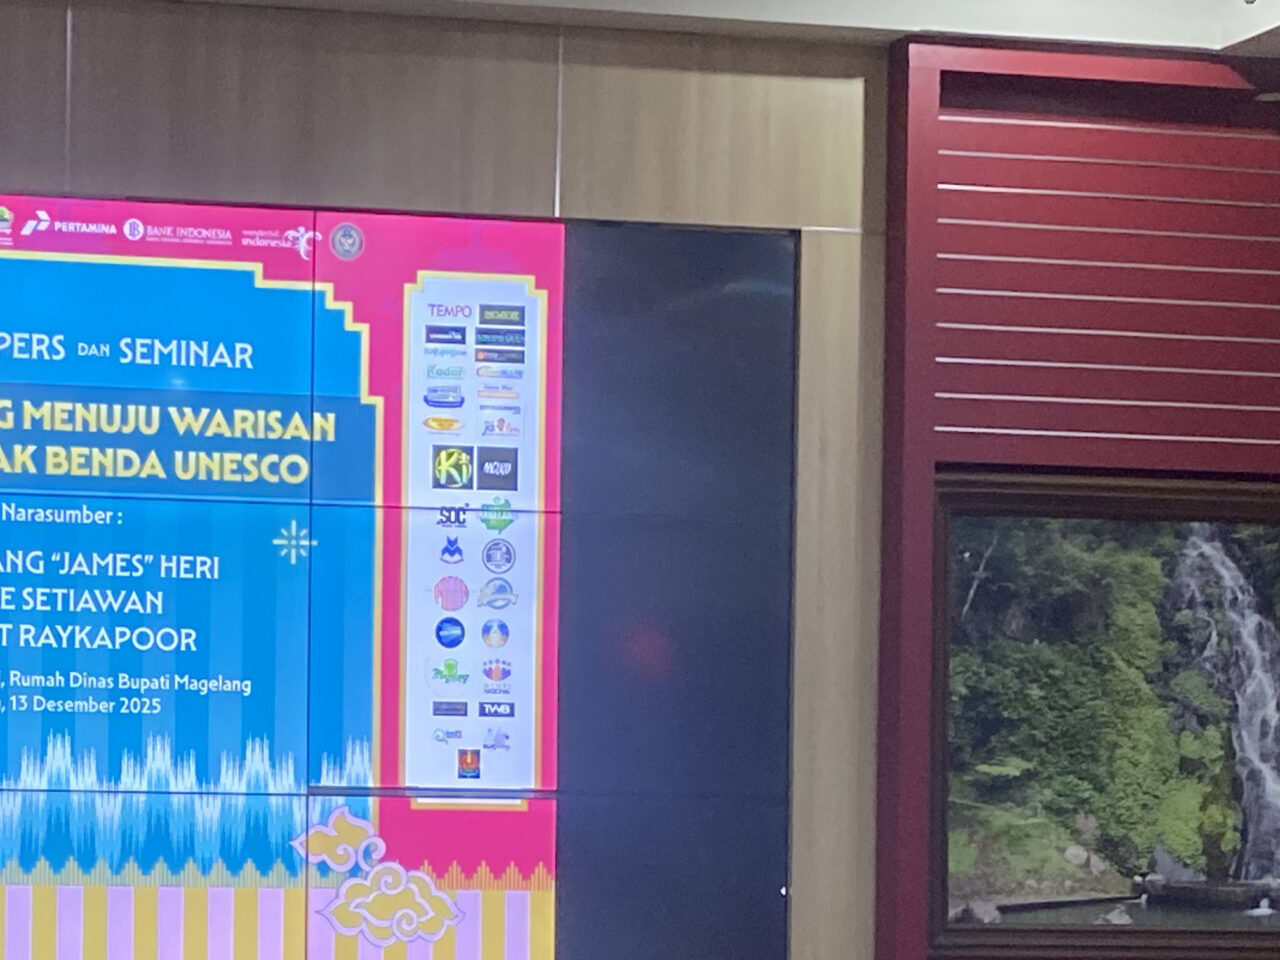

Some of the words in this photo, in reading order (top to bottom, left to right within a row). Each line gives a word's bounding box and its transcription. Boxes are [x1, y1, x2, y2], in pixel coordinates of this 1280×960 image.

[55, 220, 117, 235] PERTAMINA
[146, 225, 174, 237] BANK
[176, 226, 232, 240] INDONESIA
[427, 303, 472, 318] TEMPO
[77, 342, 110, 358] DAN
[119, 337, 254, 370] SEMINAR
[22, 400, 161, 436] MENUJU
[168, 406, 336, 442] WARISAN
[45, 445, 167, 479] BENDA
[174, 450, 310, 484] UNESCO
[1, 502, 113, 525] Narasumber
[160, 555, 220, 580] HERI
[21, 587, 164, 615] SETIAWAN
[18, 624, 197, 652] RAYKAPOOR
[9, 671, 66, 690] Rumah
[69, 673, 115, 690] Dinas
[118, 674, 170, 693] Bupati
[174, 674, 252, 697] Magelang
[9, 695, 28, 711] 13
[32, 695, 116, 714] Desember
[120, 697, 161, 714] 2025
